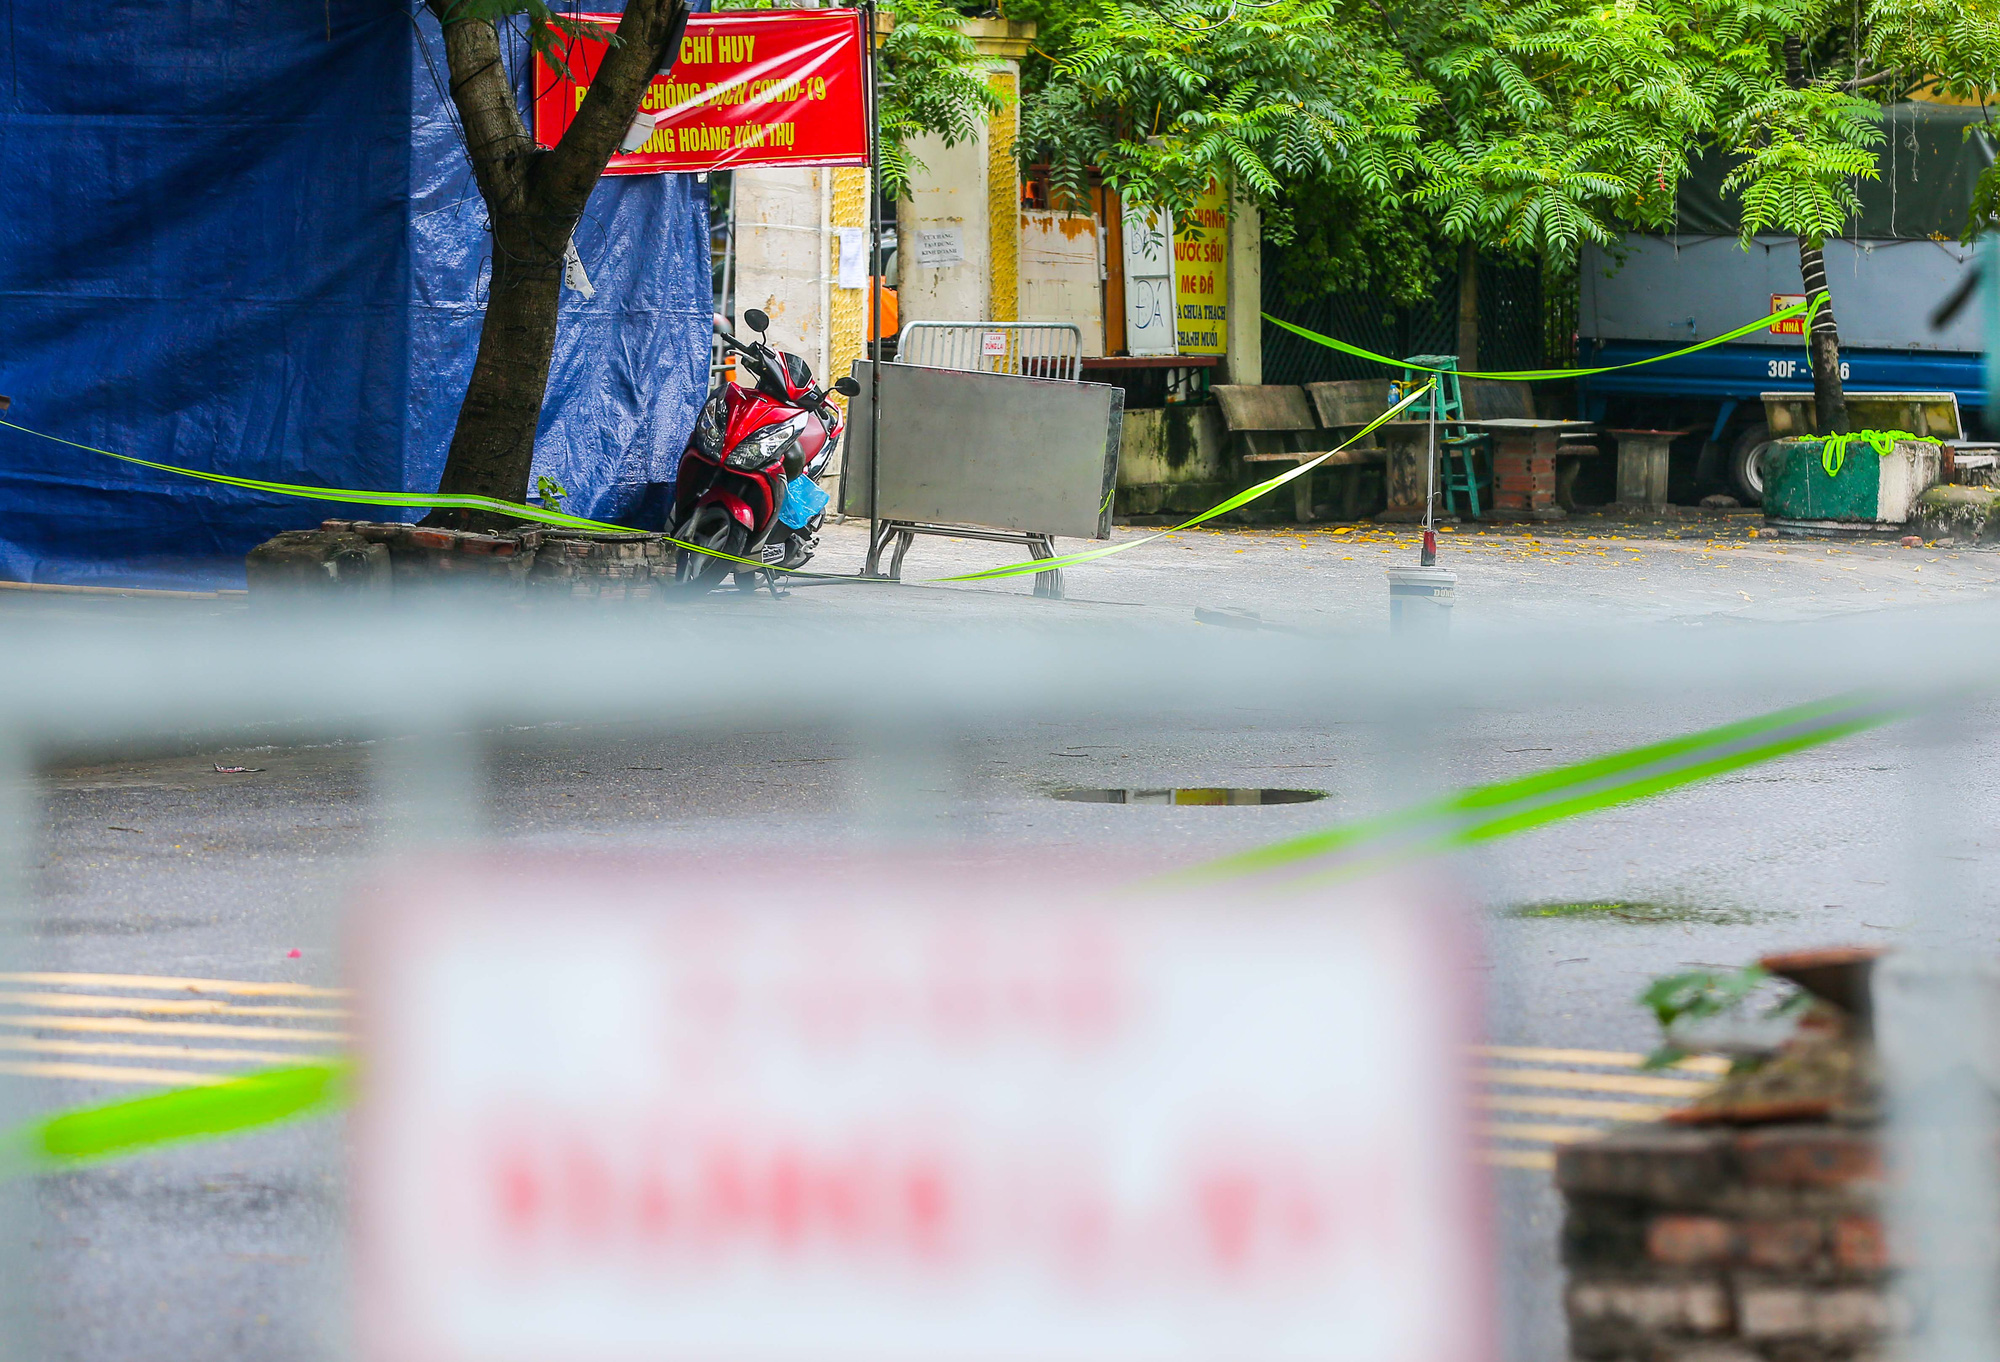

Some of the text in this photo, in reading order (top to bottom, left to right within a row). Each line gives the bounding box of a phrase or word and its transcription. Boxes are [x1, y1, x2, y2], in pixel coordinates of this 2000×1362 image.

[680, 27, 755, 65] CHỈ HUY
[643, 75, 826, 111] CHỐNG DỊCH COVID-19
[678, 122, 731, 152] HOÀNG
[734, 120, 765, 149] VĂN
[766, 122, 795, 151] THỤ
[1181, 270, 1214, 294] ME ĐÁ
[1184, 304, 1203, 320] CHUA
[1768, 360, 1796, 378] 30F
